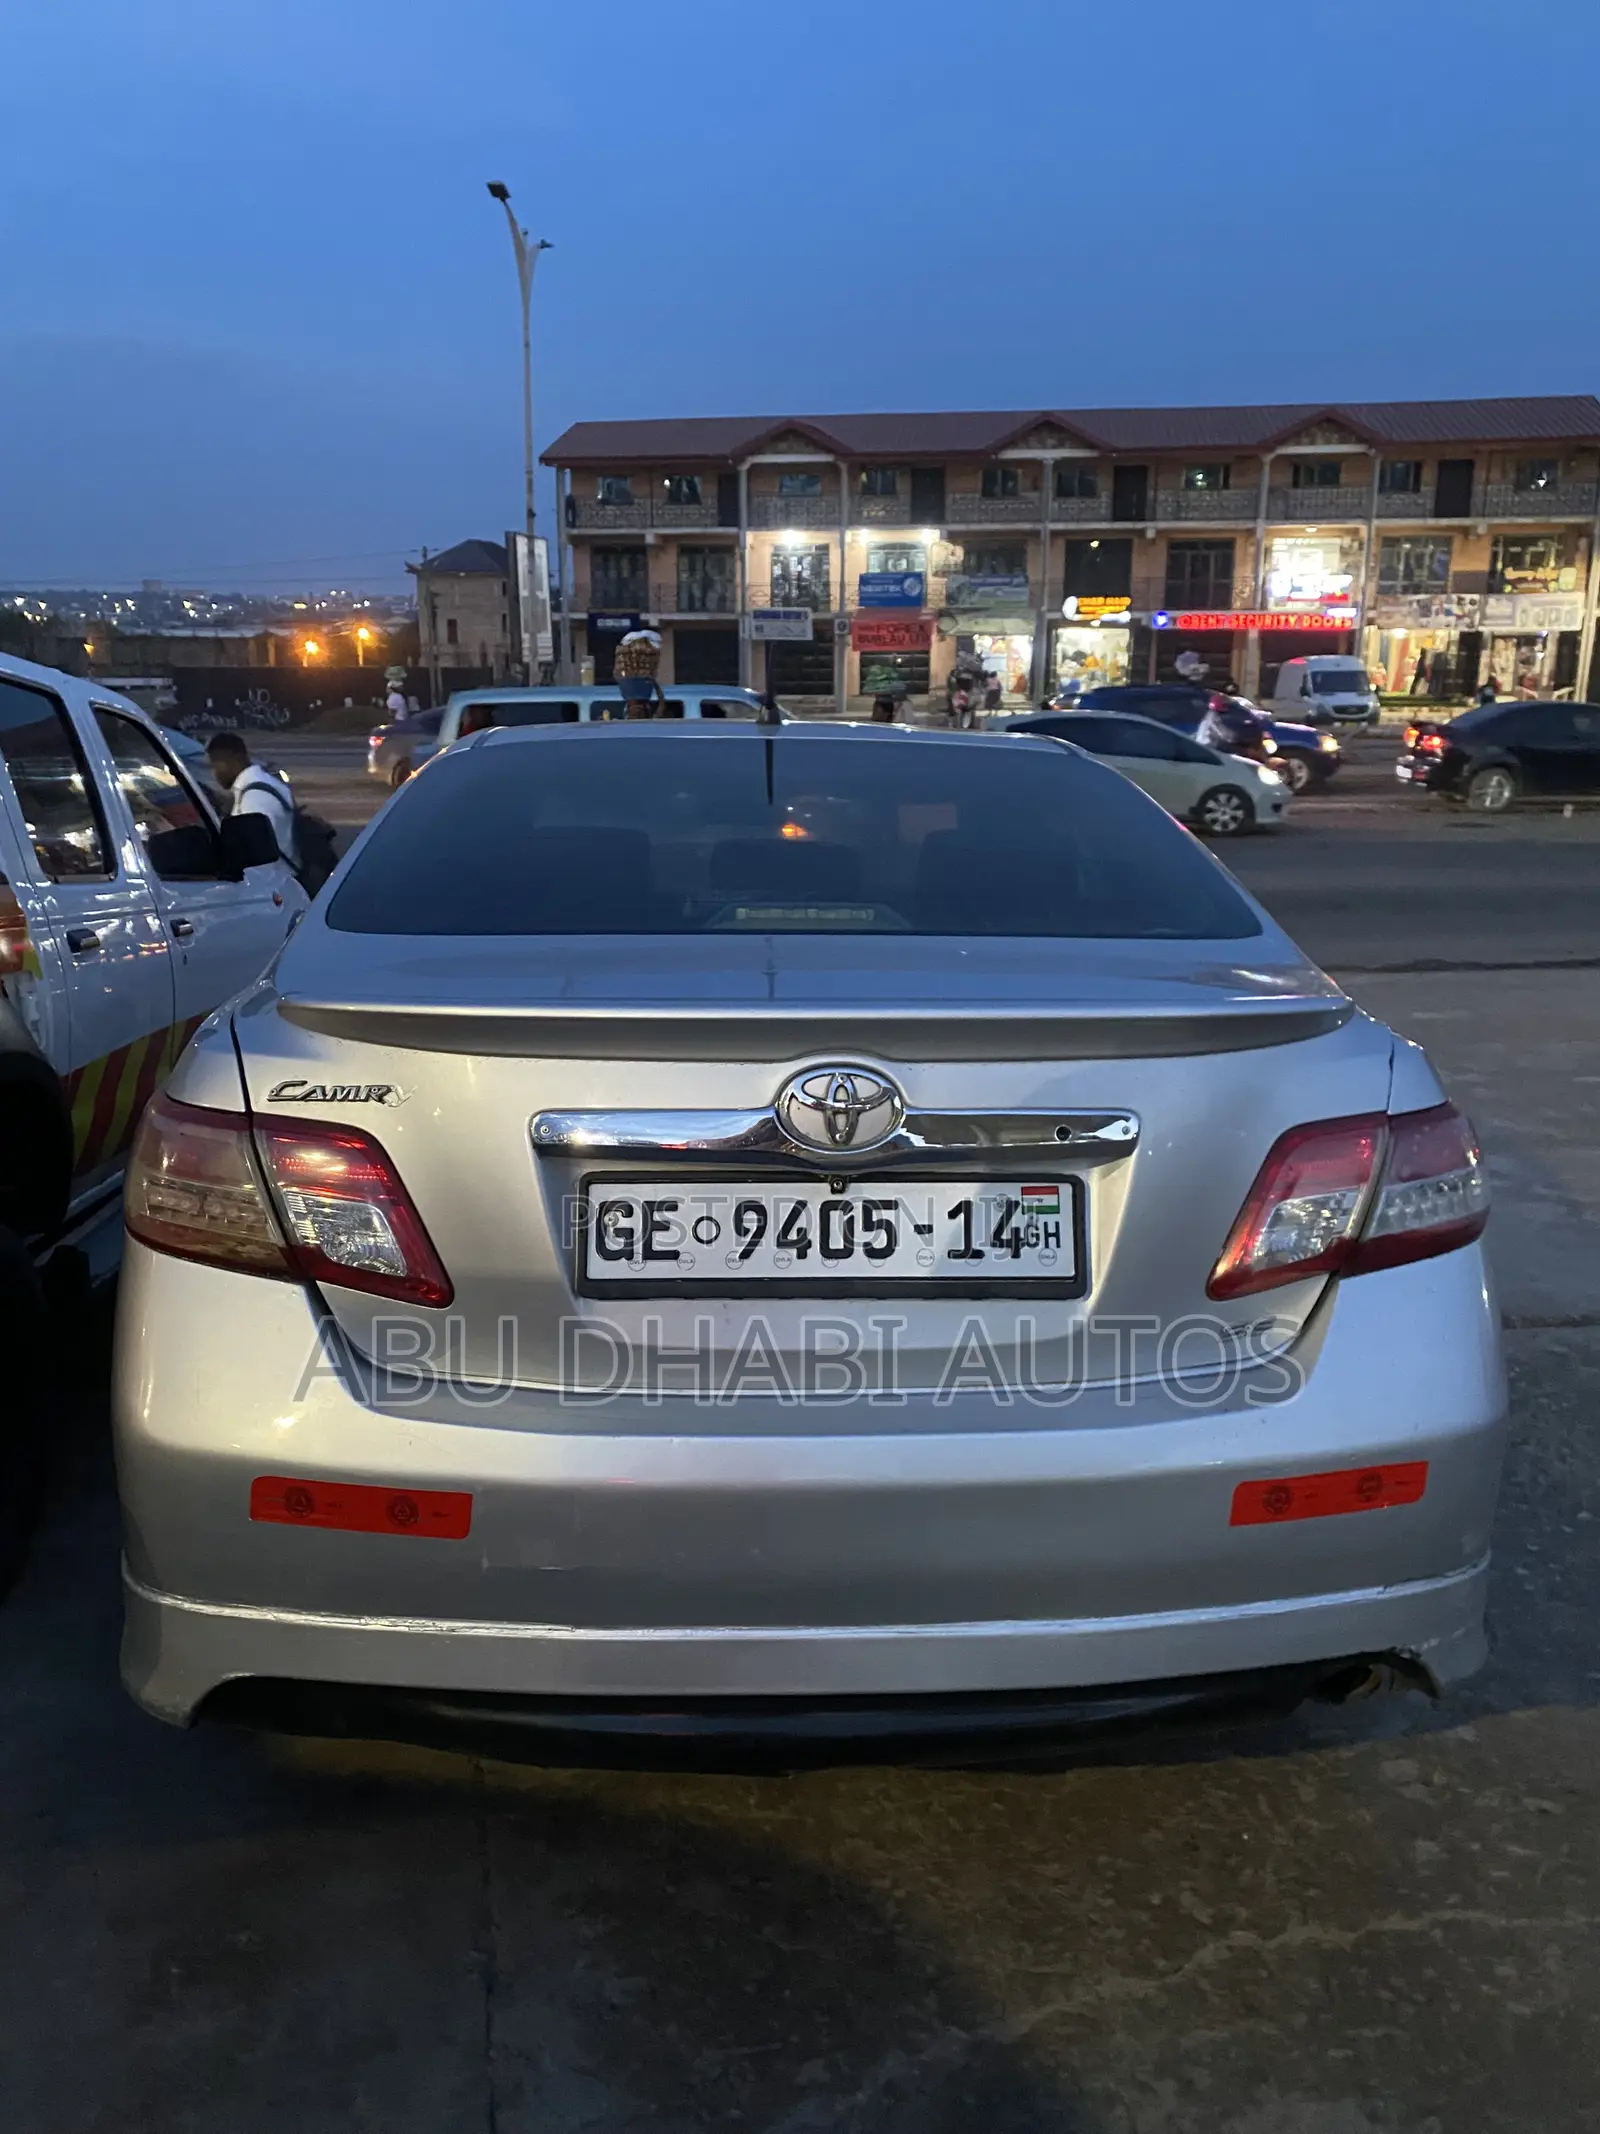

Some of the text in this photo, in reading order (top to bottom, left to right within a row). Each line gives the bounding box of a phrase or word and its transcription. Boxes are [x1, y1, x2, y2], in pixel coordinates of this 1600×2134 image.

[1230, 614, 1298, 629] SECURITY
[1302, 614, 1352, 629] DOORS
[595, 1199, 681, 1261] GE
[1023, 1220, 1062, 1250] GH
